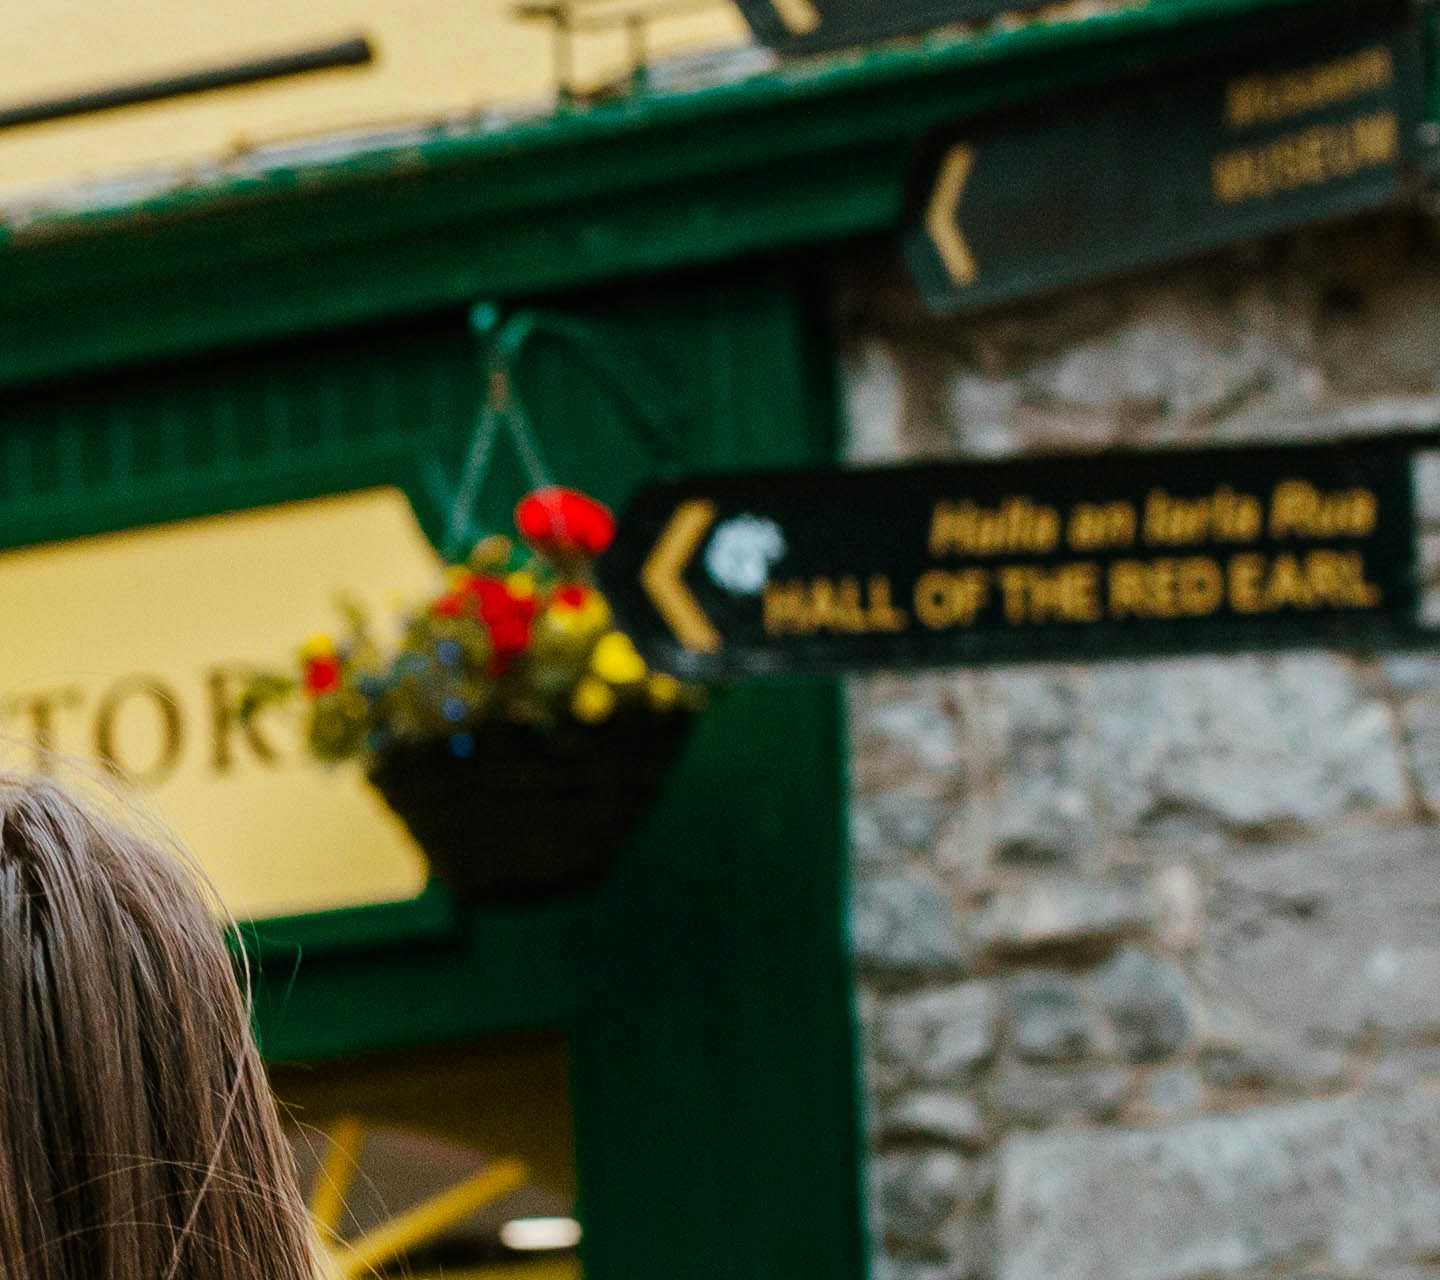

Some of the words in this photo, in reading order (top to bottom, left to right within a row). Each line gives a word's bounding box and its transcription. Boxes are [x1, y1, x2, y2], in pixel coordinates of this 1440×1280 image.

[1065, 500, 1136, 552] an
[1269, 476, 1378, 539] Rua
[761, 570, 908, 636] HALL
[913, 565, 992, 629] OF
[996, 557, 1102, 625] THE
[1106, 553, 1223, 621] RED
[1226, 547, 1382, 617] EARL
